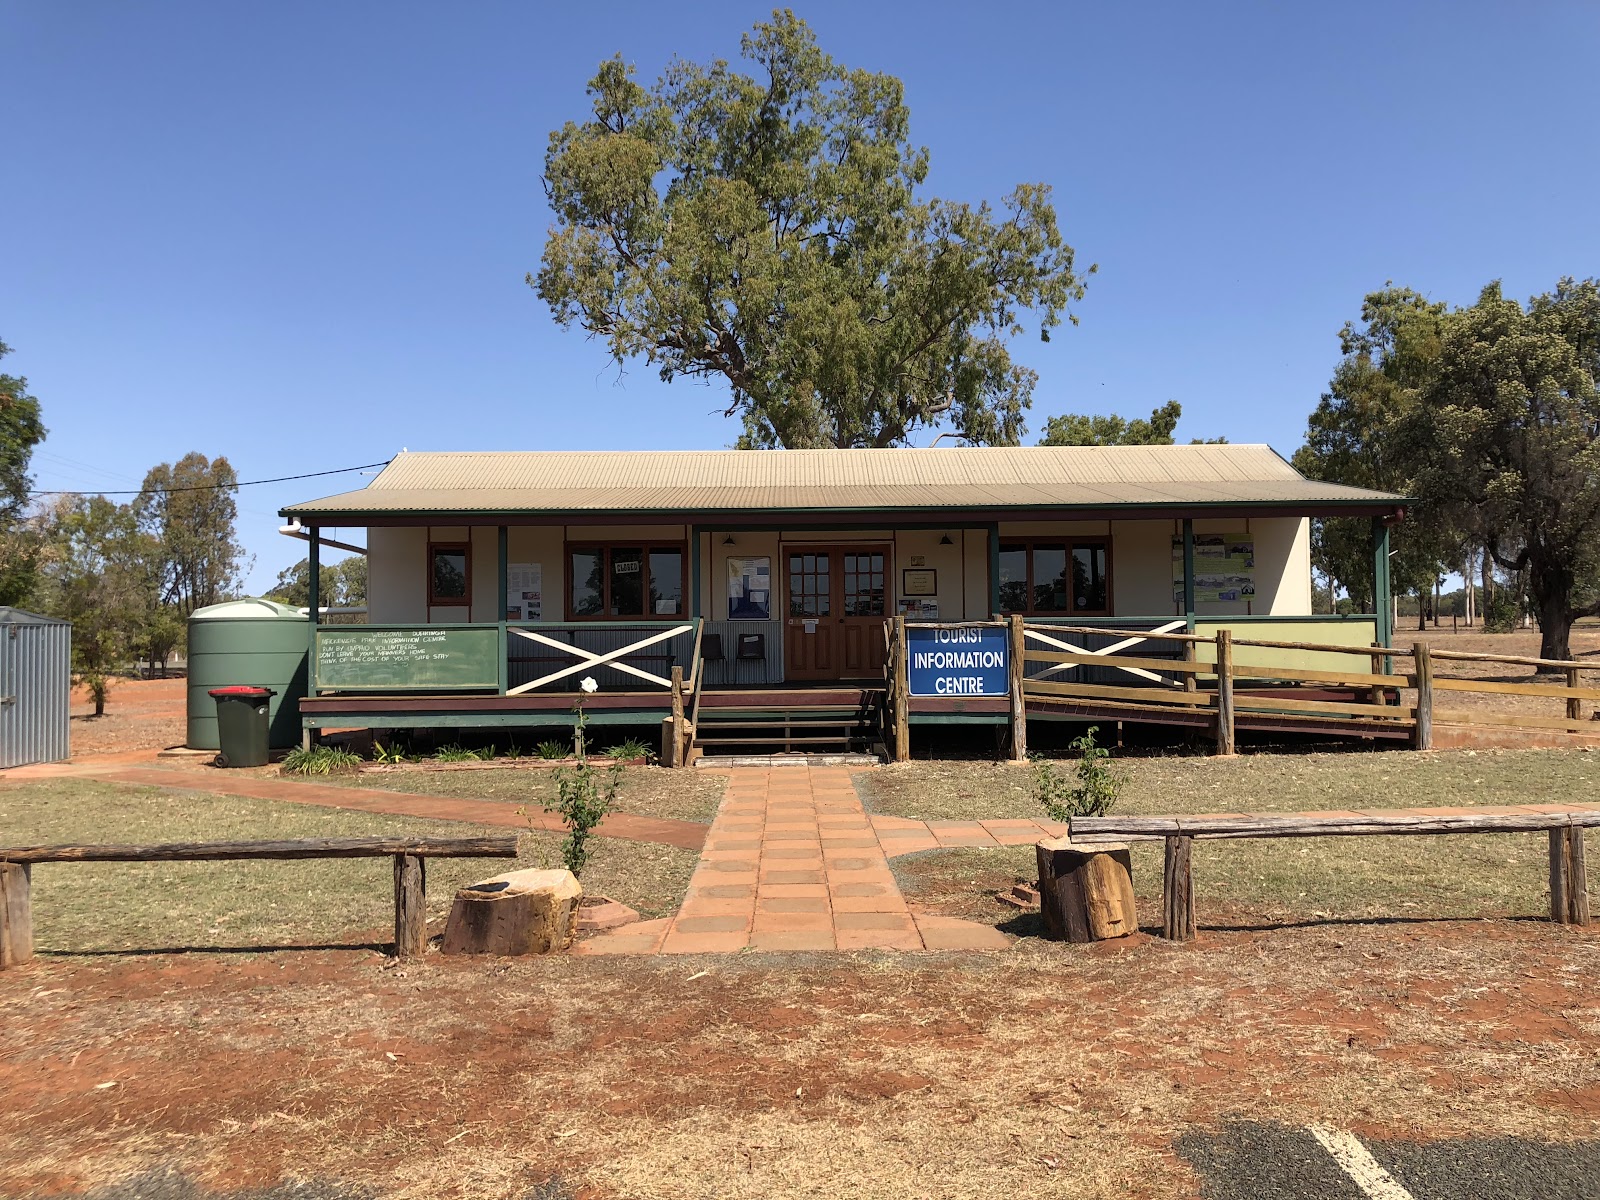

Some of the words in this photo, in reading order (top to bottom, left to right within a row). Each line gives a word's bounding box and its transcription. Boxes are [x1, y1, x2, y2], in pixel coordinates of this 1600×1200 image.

[616, 562, 638, 572] CLOSED
[371, 631, 403, 639] WELCOME
[934, 628, 983, 643] TOURIST
[914, 651, 1003, 668] INFORMATION
[935, 677, 983, 693] CENTRE
